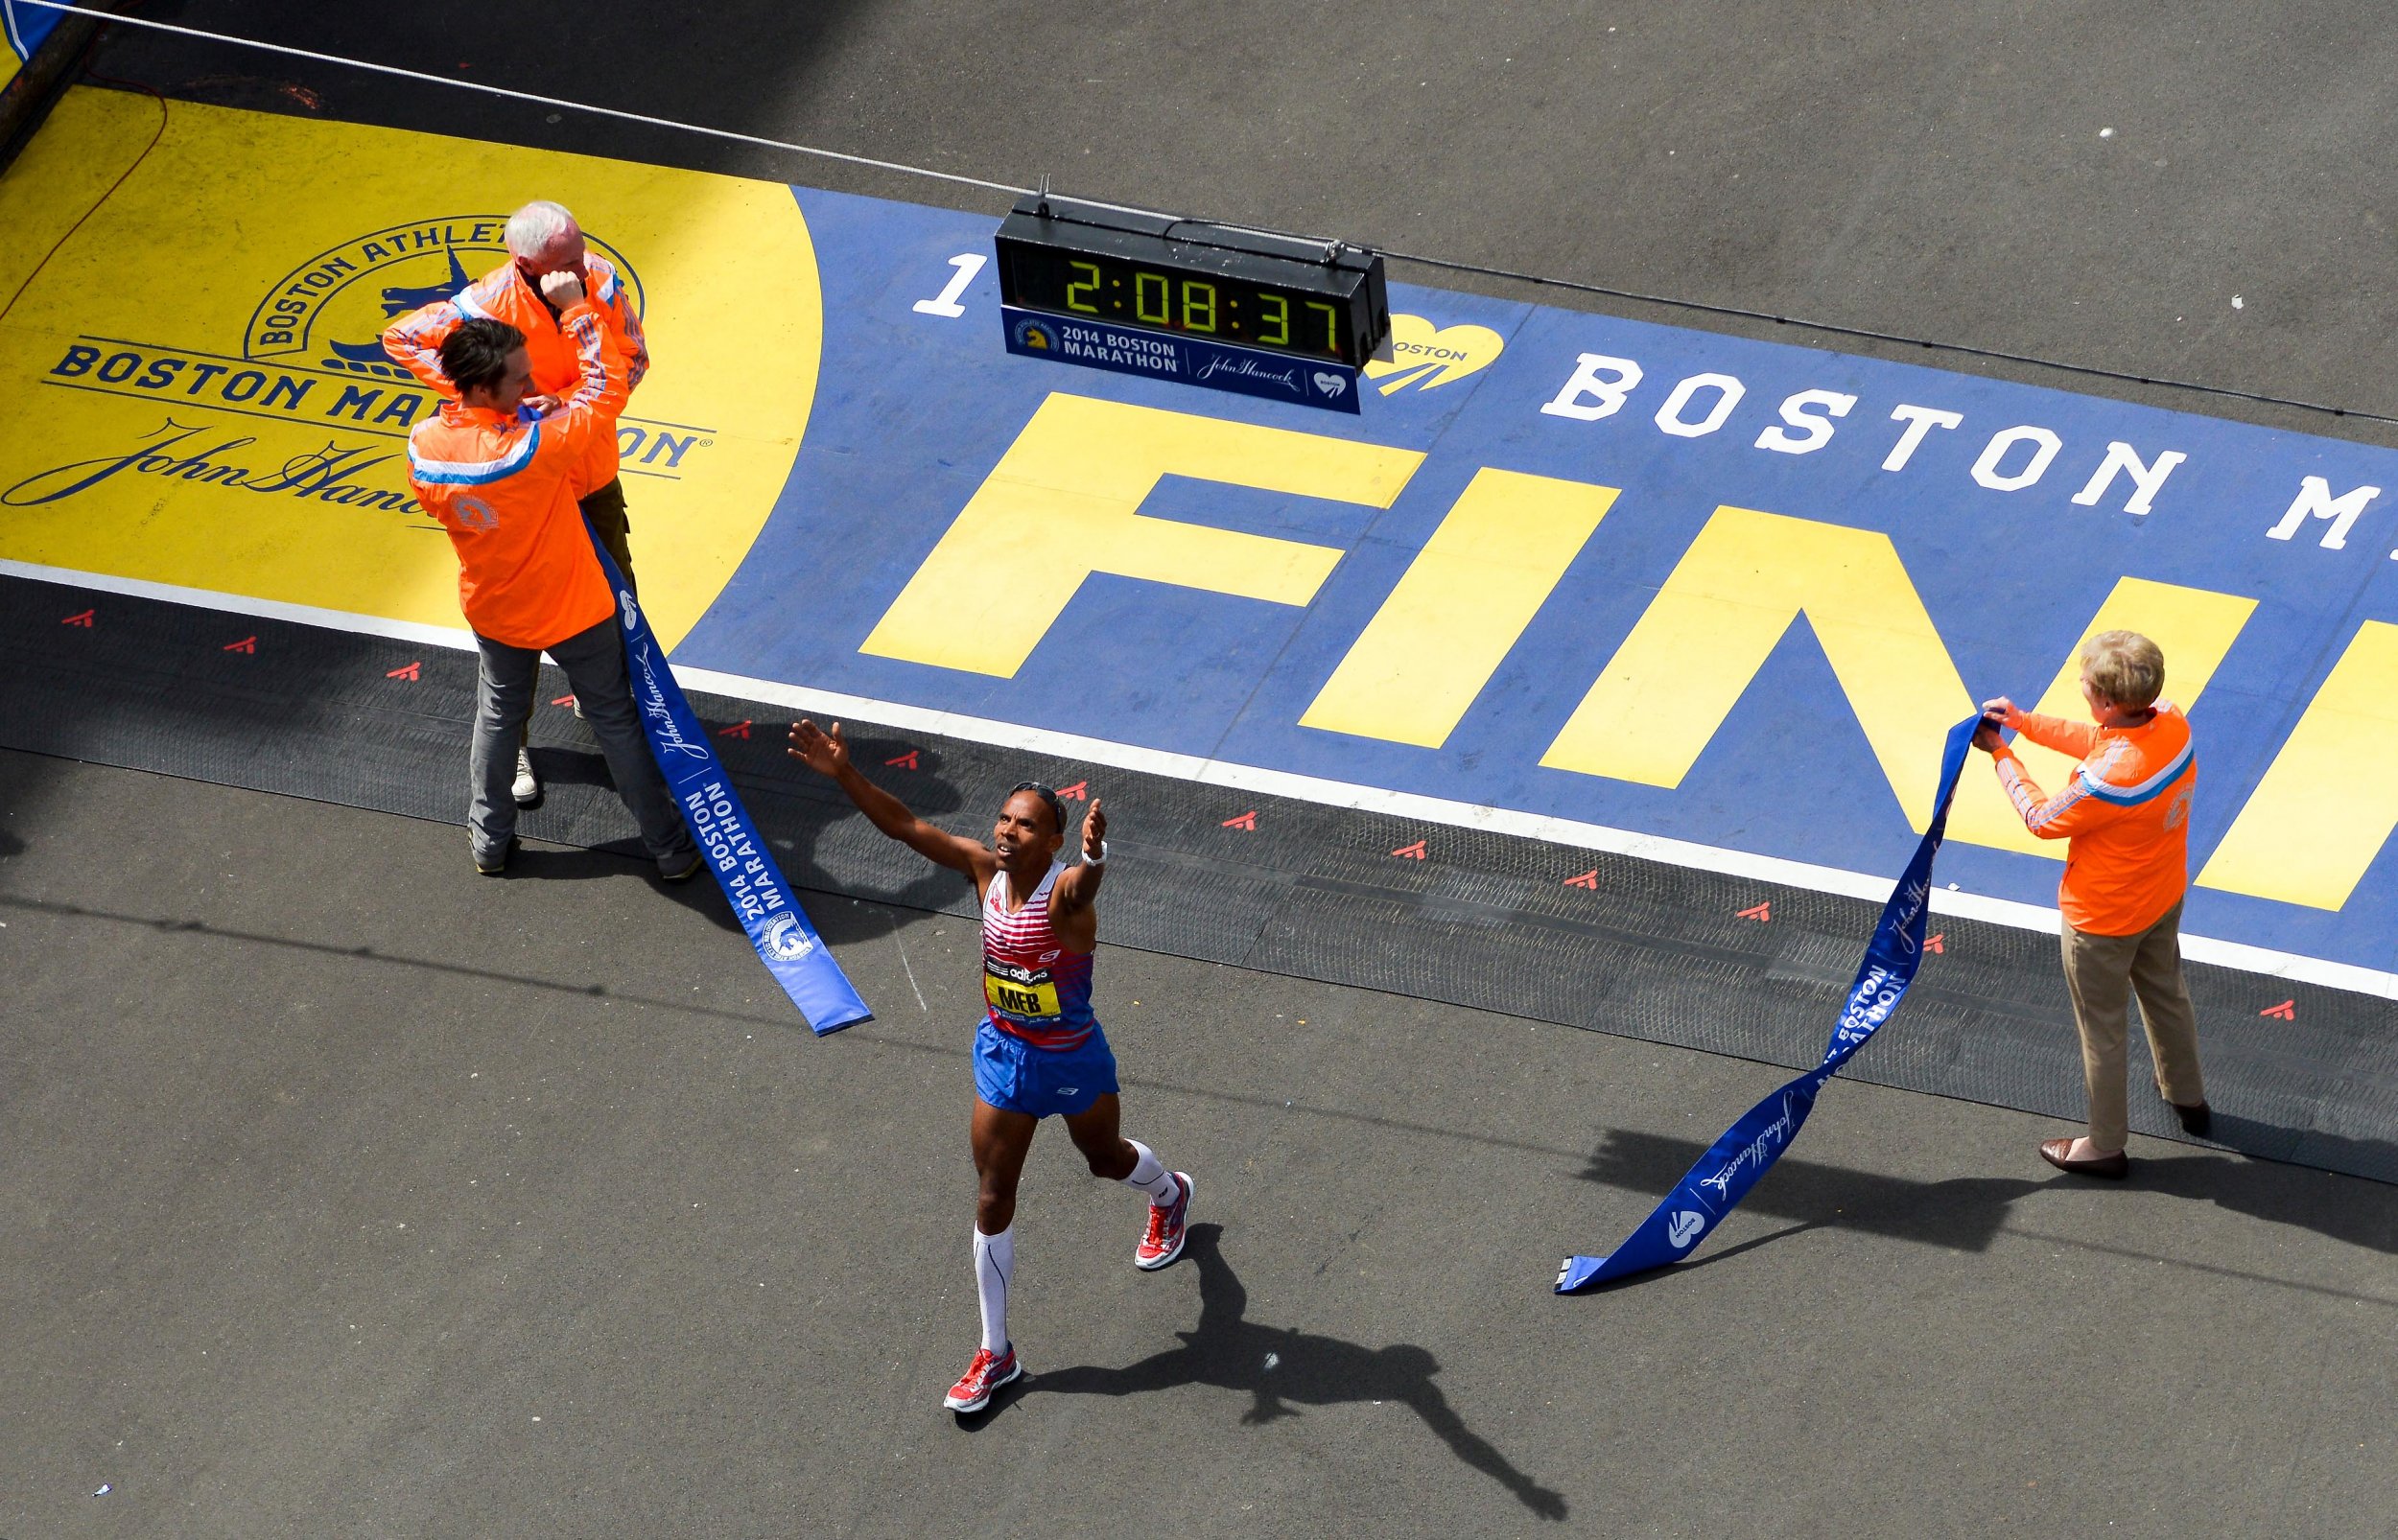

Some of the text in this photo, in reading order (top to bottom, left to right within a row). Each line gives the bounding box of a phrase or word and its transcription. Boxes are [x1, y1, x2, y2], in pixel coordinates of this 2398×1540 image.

[260, 223, 505, 345] BOSTON ATHLE
[1068, 261, 1335, 351] 2:08:37
[50, 344, 318, 409] BOSTON
[1062, 326, 1100, 344] 2014
[1106, 334, 1176, 357] BOSTON
[1064, 340, 1178, 372] MARATHON
[1197, 353, 1300, 392] John Hancock
[1393, 341, 1468, 362] OSTON
[2, 417, 251, 506] John
[244, 440, 425, 514] Hanc
[1540, 352, 2187, 516] BOSTON
[635, 642, 709, 759] John Hancock
[686, 791, 764, 921] 2014 BOSTON
[704, 782, 785, 910] MARATHON
[998, 985, 1042, 1014] MEB
[1838, 965, 1888, 1040] BOSTON
[1700, 1133, 1768, 1202] Hancock
[1675, 1218, 1696, 1239] BOSTON
